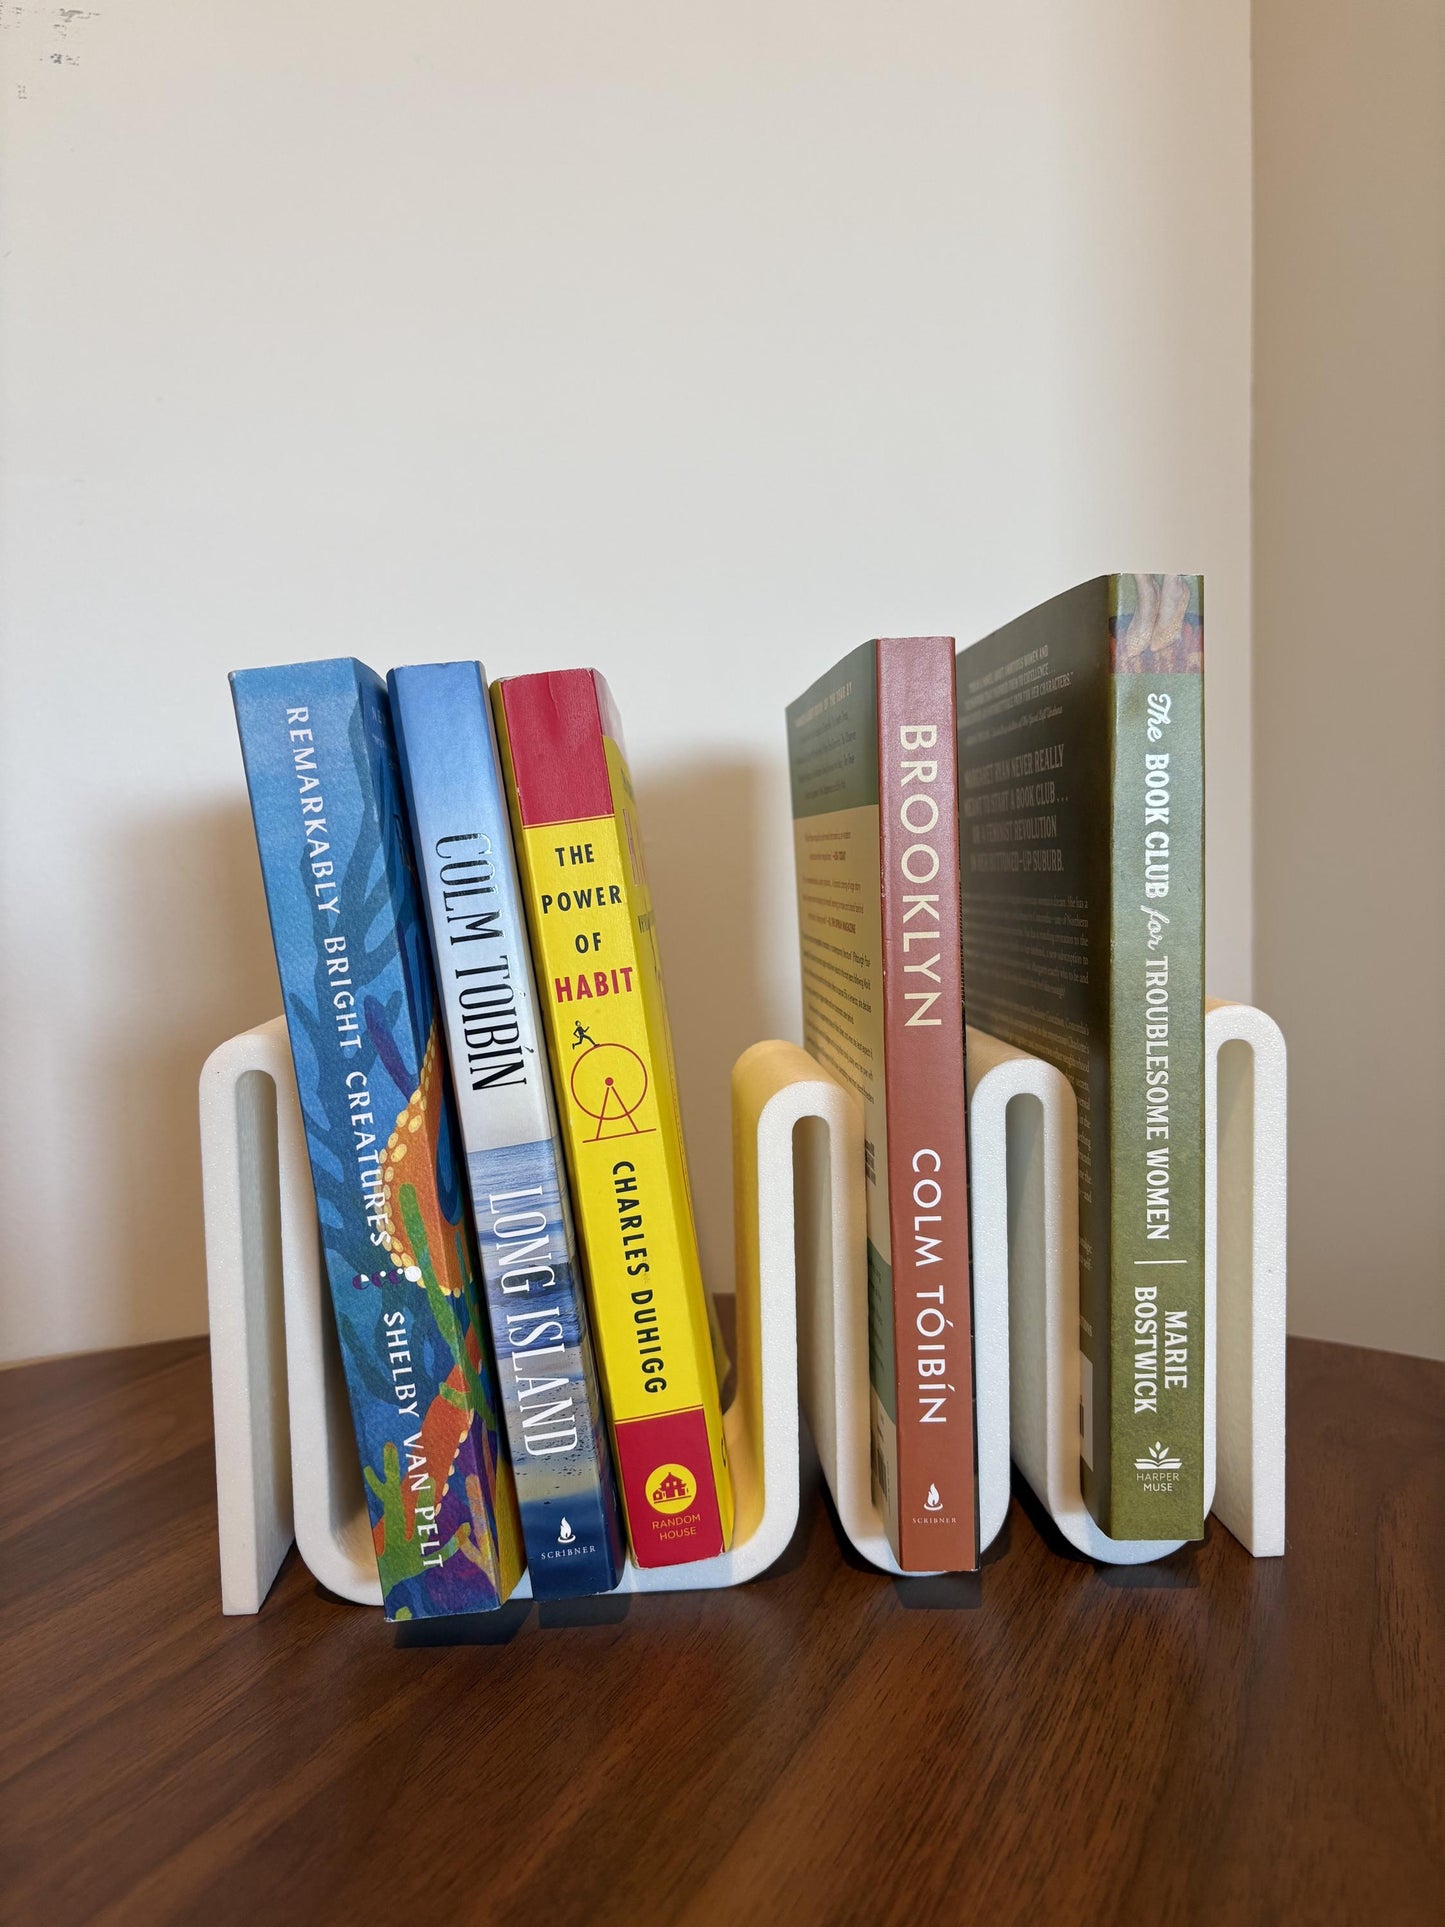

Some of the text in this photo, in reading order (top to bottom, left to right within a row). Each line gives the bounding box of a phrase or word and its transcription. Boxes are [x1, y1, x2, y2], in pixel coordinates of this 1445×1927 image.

[1146, 693, 1172, 742] The
[1034, 744, 1064, 772] REALLY
[1144, 753, 1170, 827] BOOK
[1016, 785, 1035, 808] BOOK
[434, 832, 505, 946] COLM
[554, 844, 595, 866] THE
[899, 725, 943, 1027] BROOKLYN
[1144, 829, 1170, 899] CLUB
[541, 885, 623, 914] POWER
[285, 706, 392, 1248] REMARKABLY BRIGHT CREATURES
[575, 933, 602, 954] OF
[554, 968, 634, 1002] HABIT
[1144, 956, 1169, 1141] TROUBLESOME
[1146, 1145, 1170, 1241] WOMEN
[612, 1161, 666, 1394] CHARLES DUHIGG
[912, 1148, 956, 1424] COLM TÓIBÍN
[488, 1185, 579, 1457] LONG ISLAND
[1134, 1286, 1158, 1413] BOSTWICK
[1164, 1310, 1188, 1389] MARIE
[382, 1312, 444, 1569] SHELBY VAN PELT
[1136, 1472, 1180, 1481] HARPER
[1143, 1483, 1173, 1491] MUSE
[541, 1545, 596, 1560] SCRIBNER
[652, 1514, 701, 1530] RANDOM
[659, 1527, 697, 1540] HOUSE
